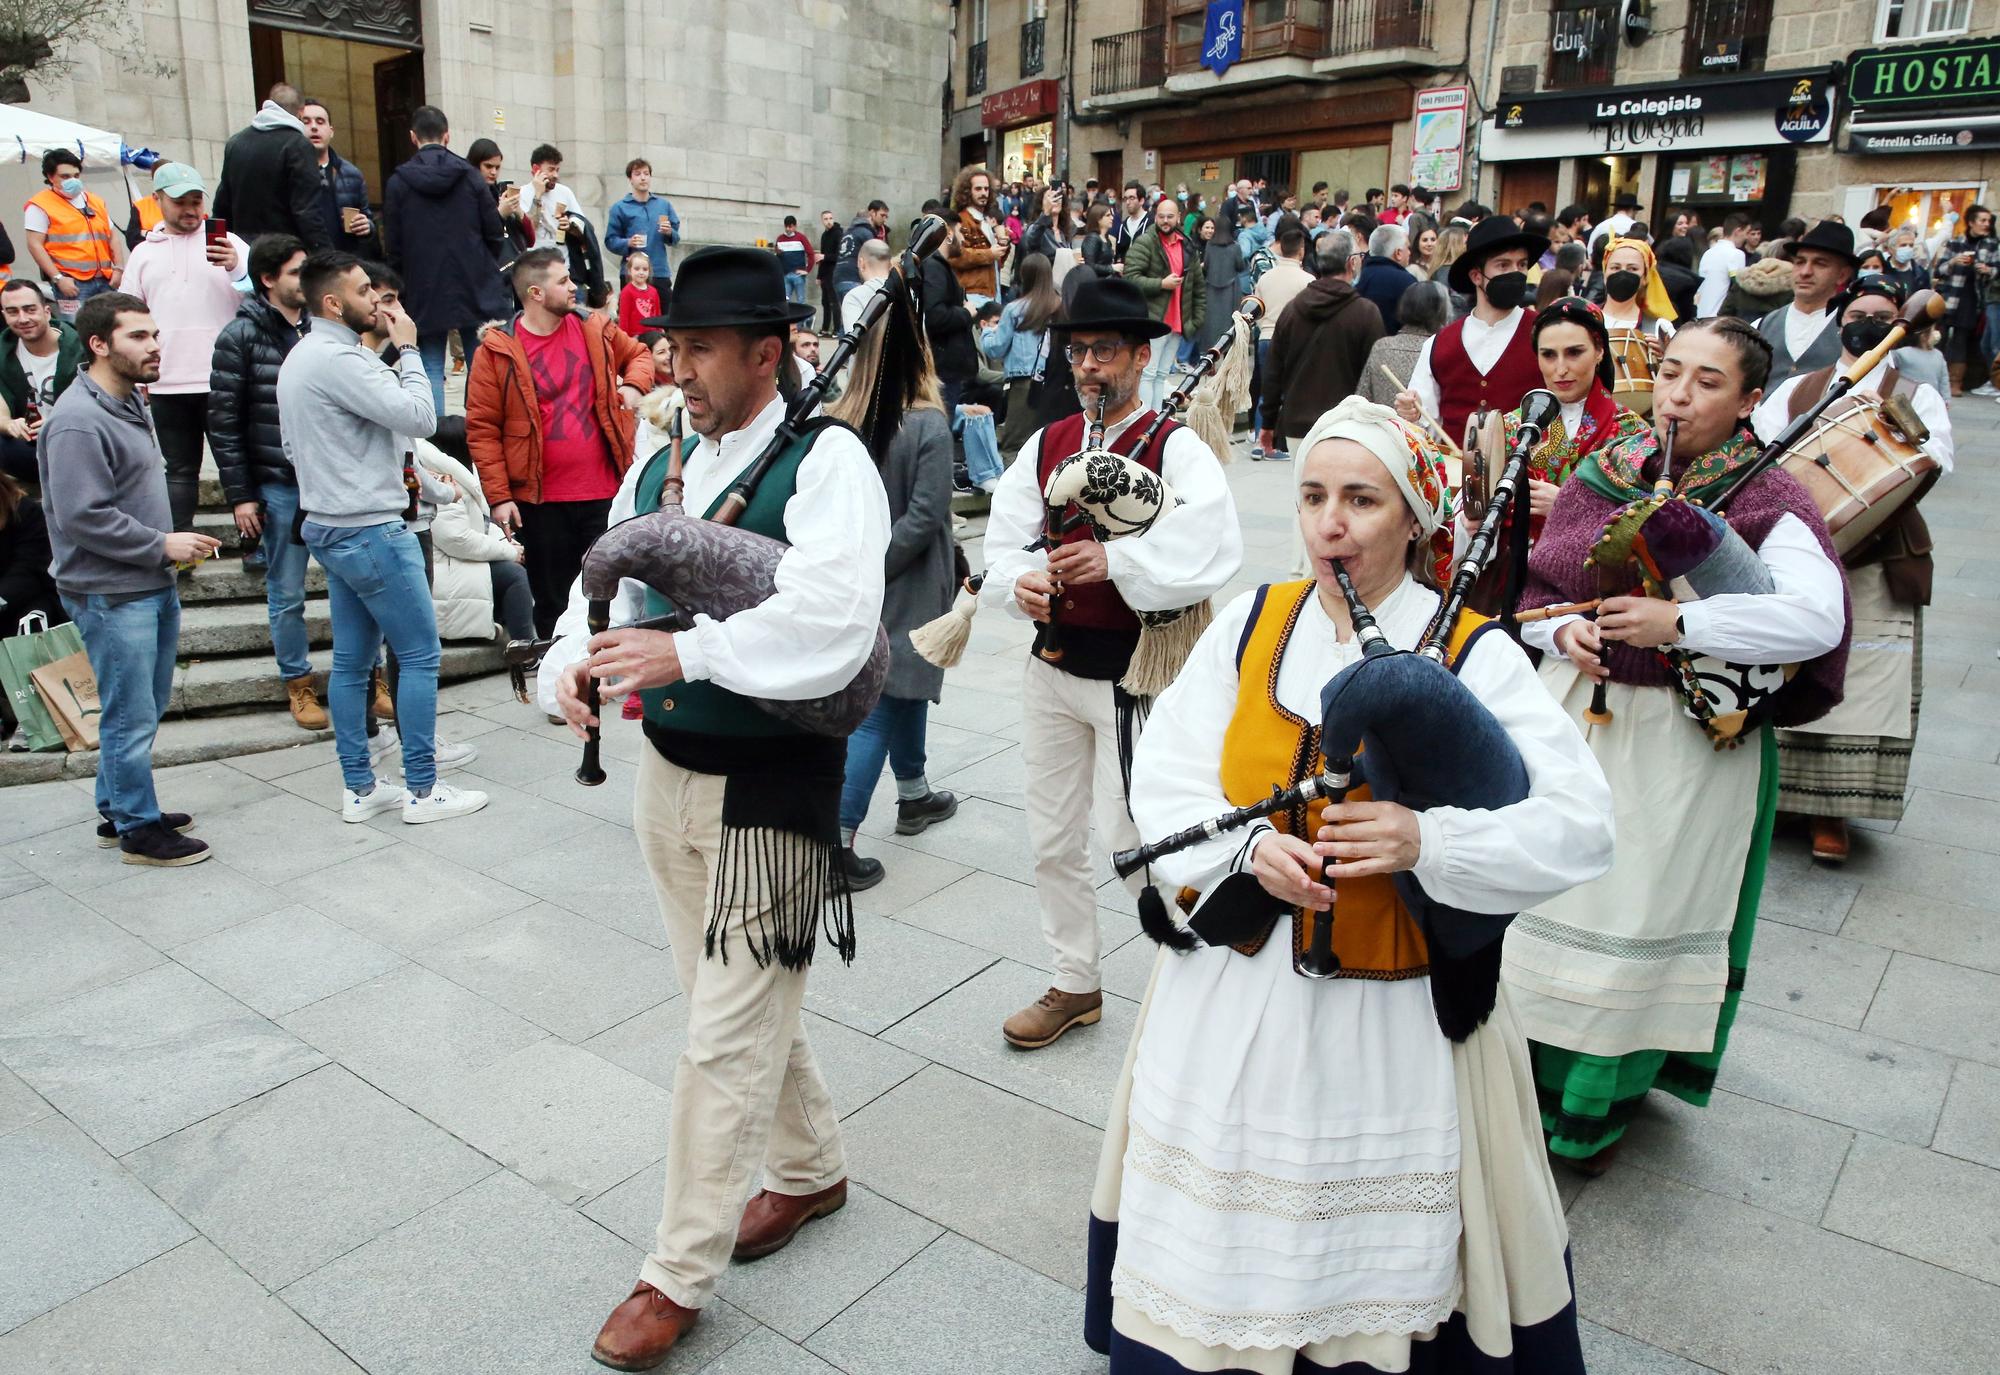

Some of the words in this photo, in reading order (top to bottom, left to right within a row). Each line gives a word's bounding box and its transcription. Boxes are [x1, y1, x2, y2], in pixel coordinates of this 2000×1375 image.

[1702, 54, 1738, 66] GUINNESS
[1873, 53, 2000, 95] HOSTA
[1596, 103, 1617, 117] La
[1620, 94, 1702, 116] Colegiala
[1866, 136, 1911, 148] Estrella
[1912, 133, 1954, 147] Galicia
